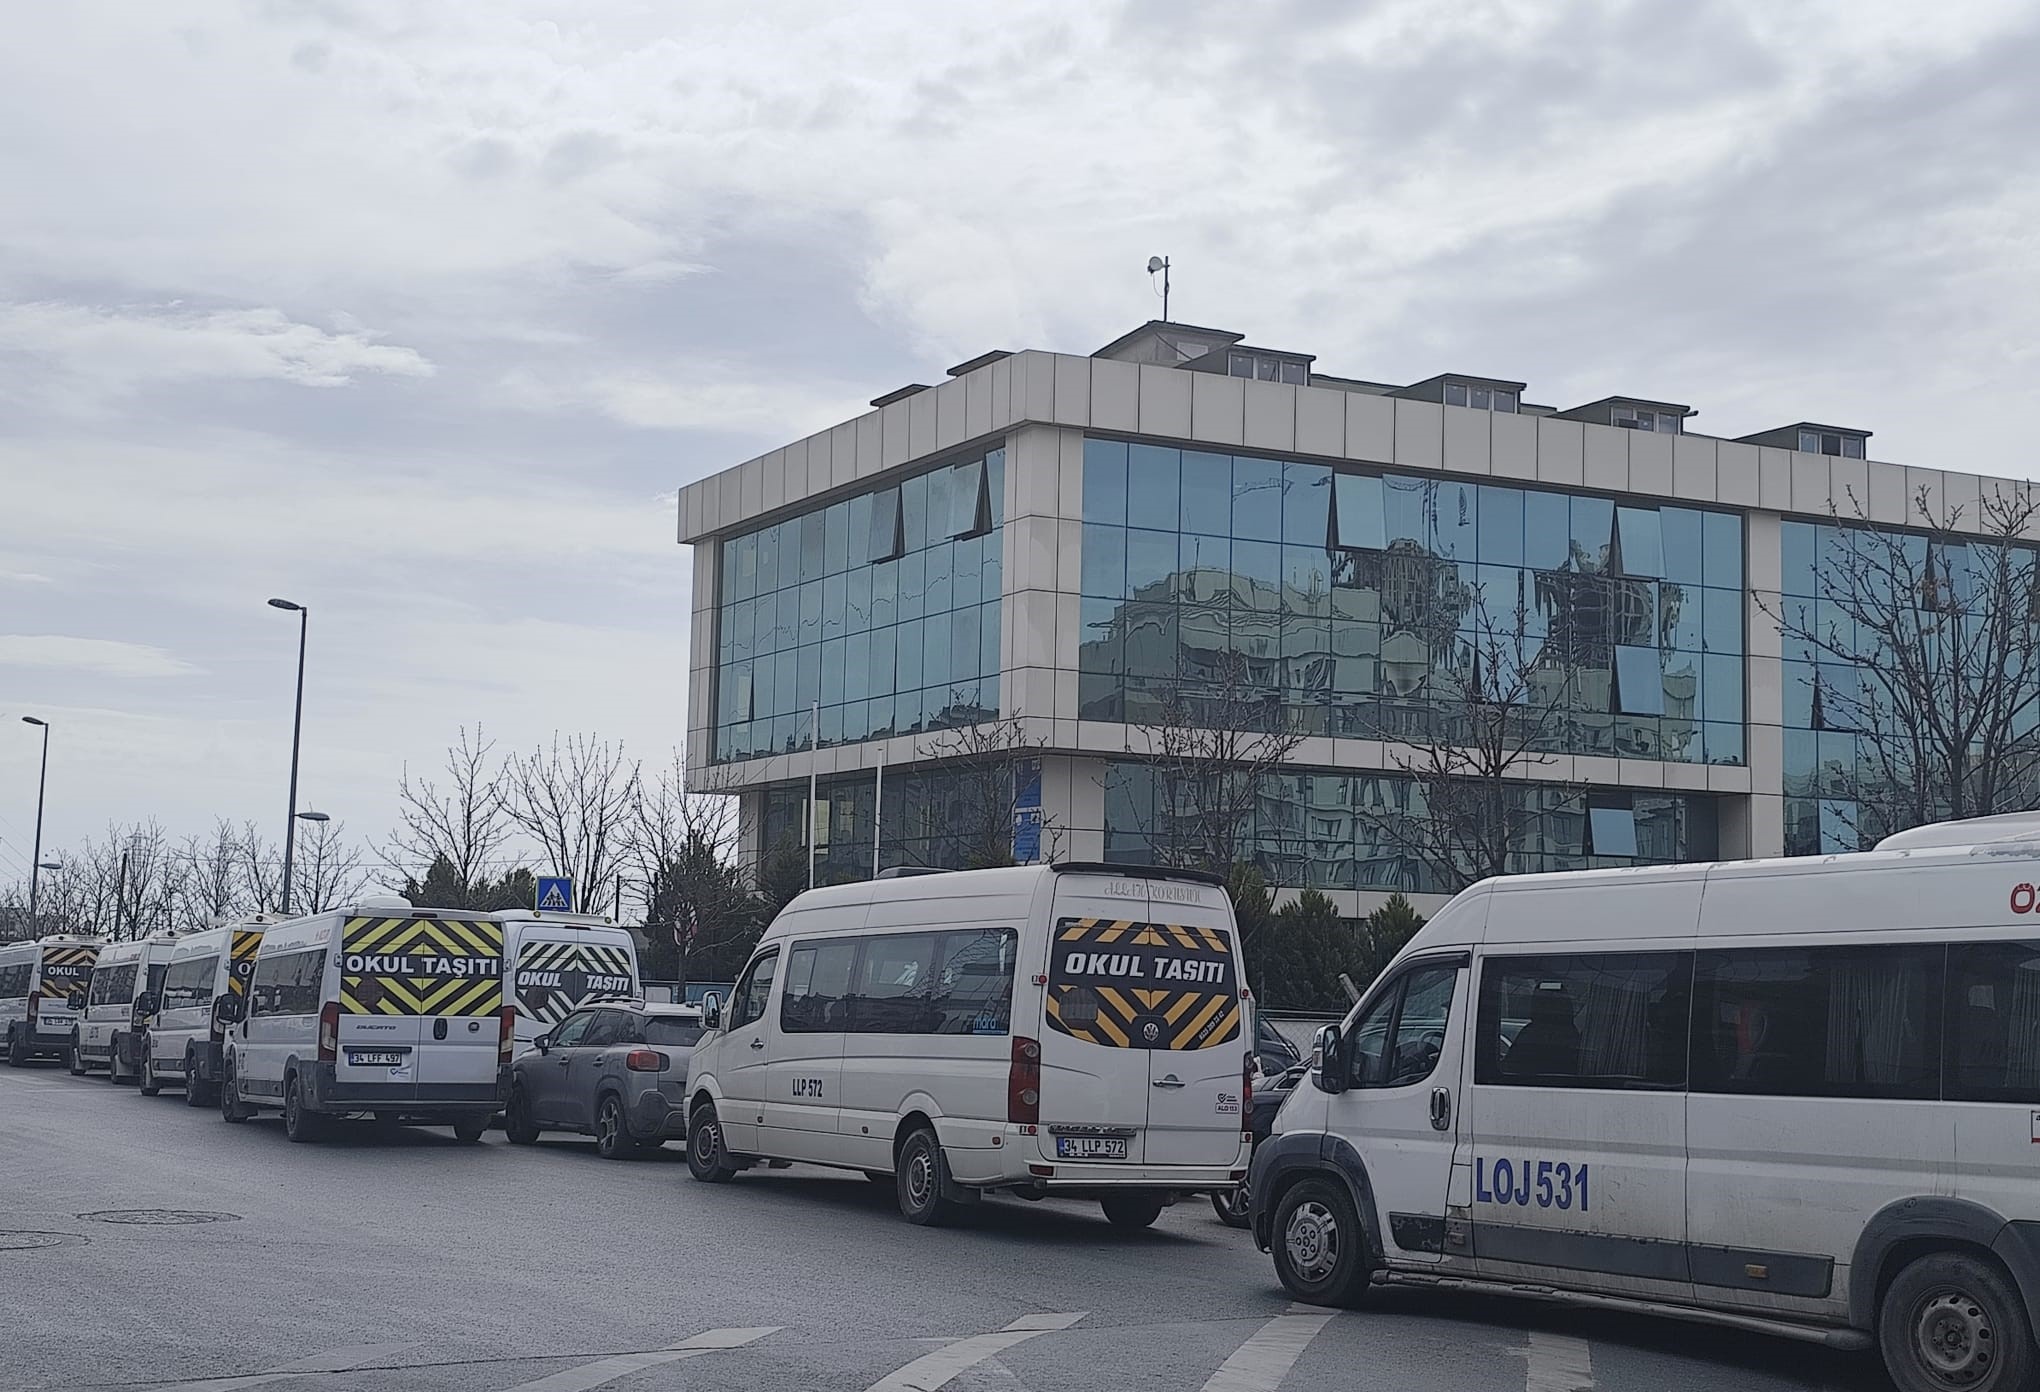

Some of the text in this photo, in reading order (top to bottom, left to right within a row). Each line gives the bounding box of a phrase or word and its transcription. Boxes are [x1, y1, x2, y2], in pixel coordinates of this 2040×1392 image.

[48, 966, 79, 976] OKUL
[346, 956, 497, 978] OKUL TAŞITI
[1065, 953, 1144, 977] OKUL
[517, 971, 562, 987] OKUL
[354, 1054, 364, 1062] 34
[367, 1054, 382, 1062] LFF
[792, 1078, 823, 1097] LLP 572
[1065, 1140, 1124, 1153] 34 LLP 572
